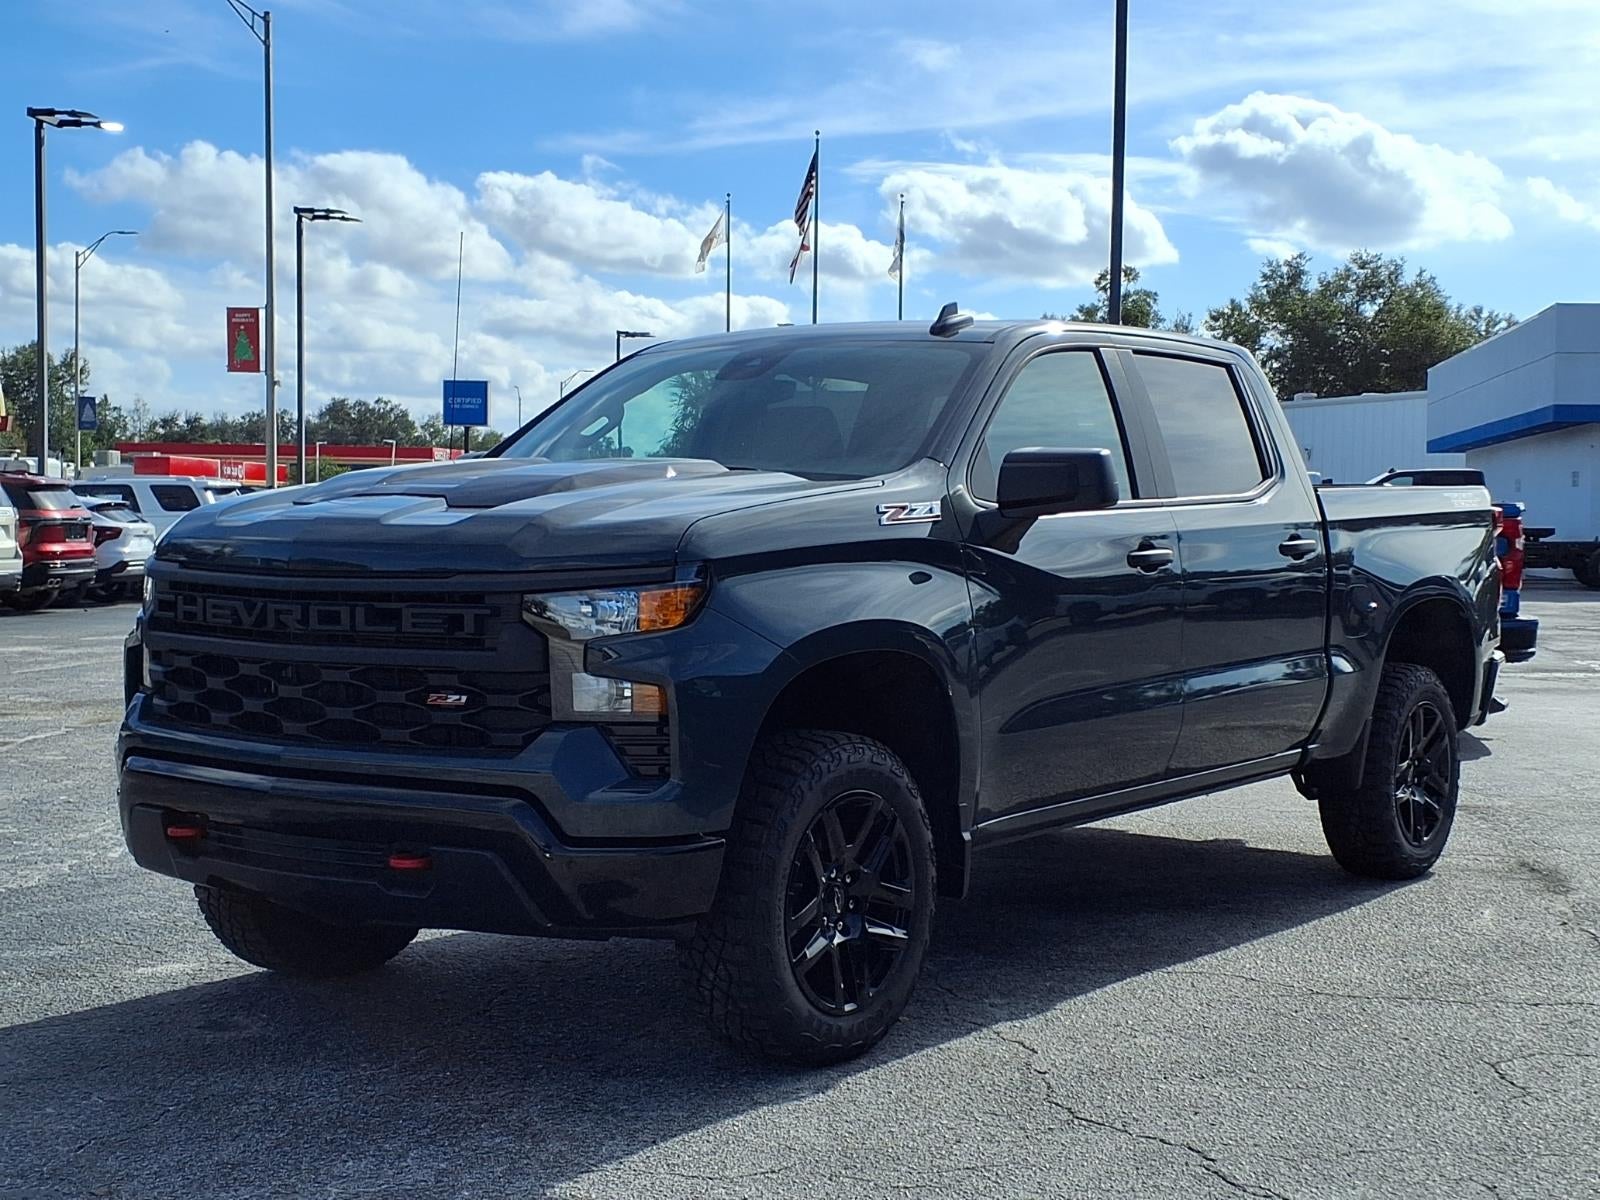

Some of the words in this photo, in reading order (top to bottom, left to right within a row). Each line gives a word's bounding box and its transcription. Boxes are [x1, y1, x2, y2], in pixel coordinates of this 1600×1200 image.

[879, 501, 942, 525] Z71
[154, 593, 491, 634] CHEVROLET
[426, 693, 467, 706] Z71
